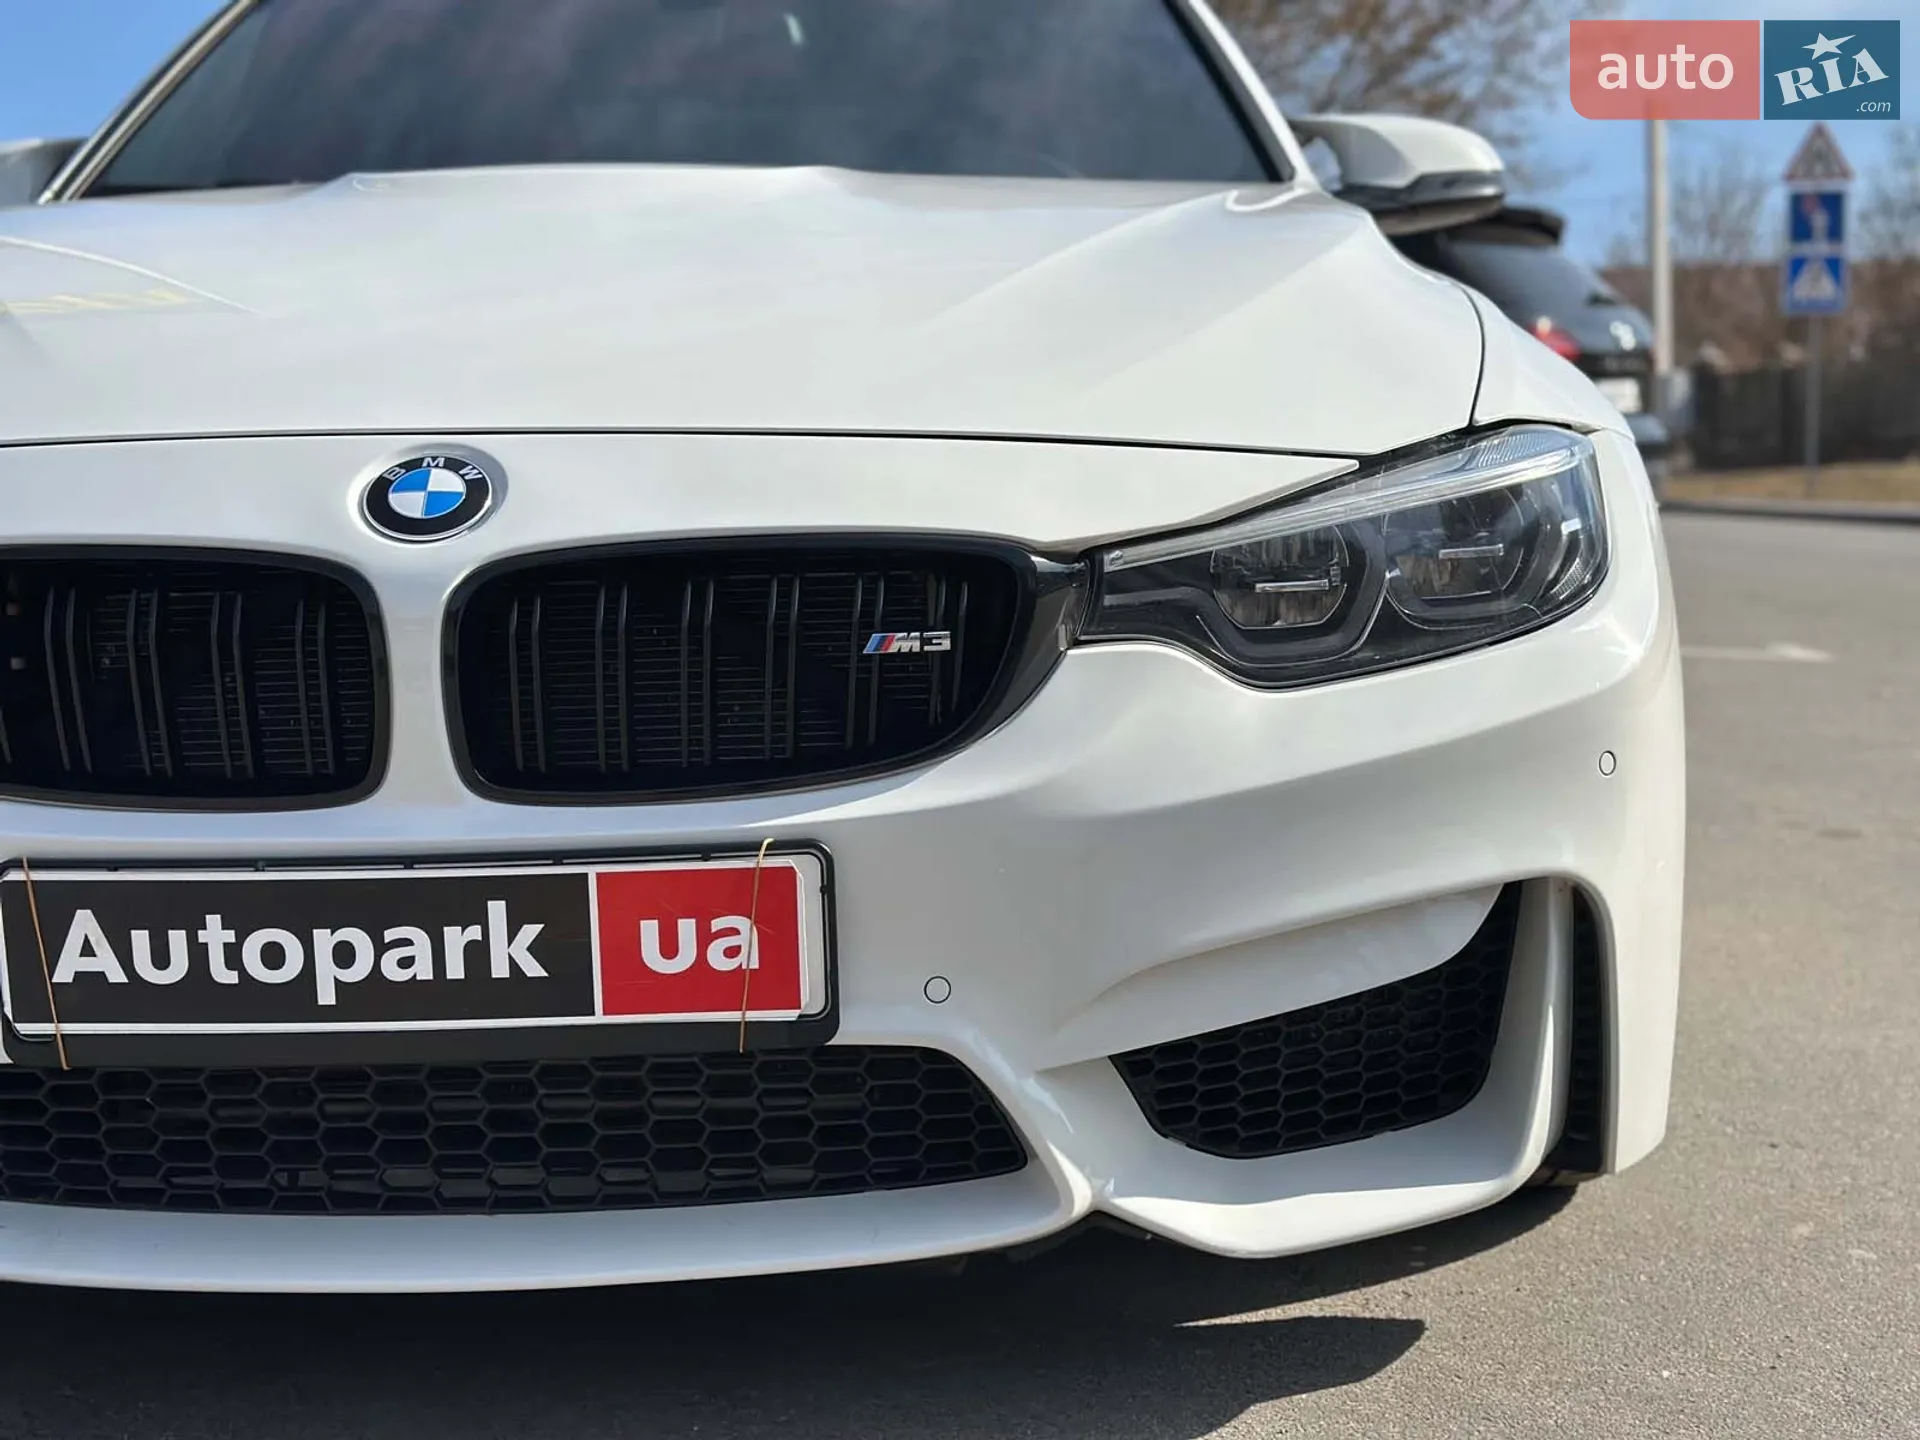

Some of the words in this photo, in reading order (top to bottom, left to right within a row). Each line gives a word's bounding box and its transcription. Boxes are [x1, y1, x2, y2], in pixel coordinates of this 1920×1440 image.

[382, 457, 483, 481] BMW
[886, 631, 952, 653] M3
[51, 899, 549, 1006] Autopark
[638, 912, 760, 974] ua
